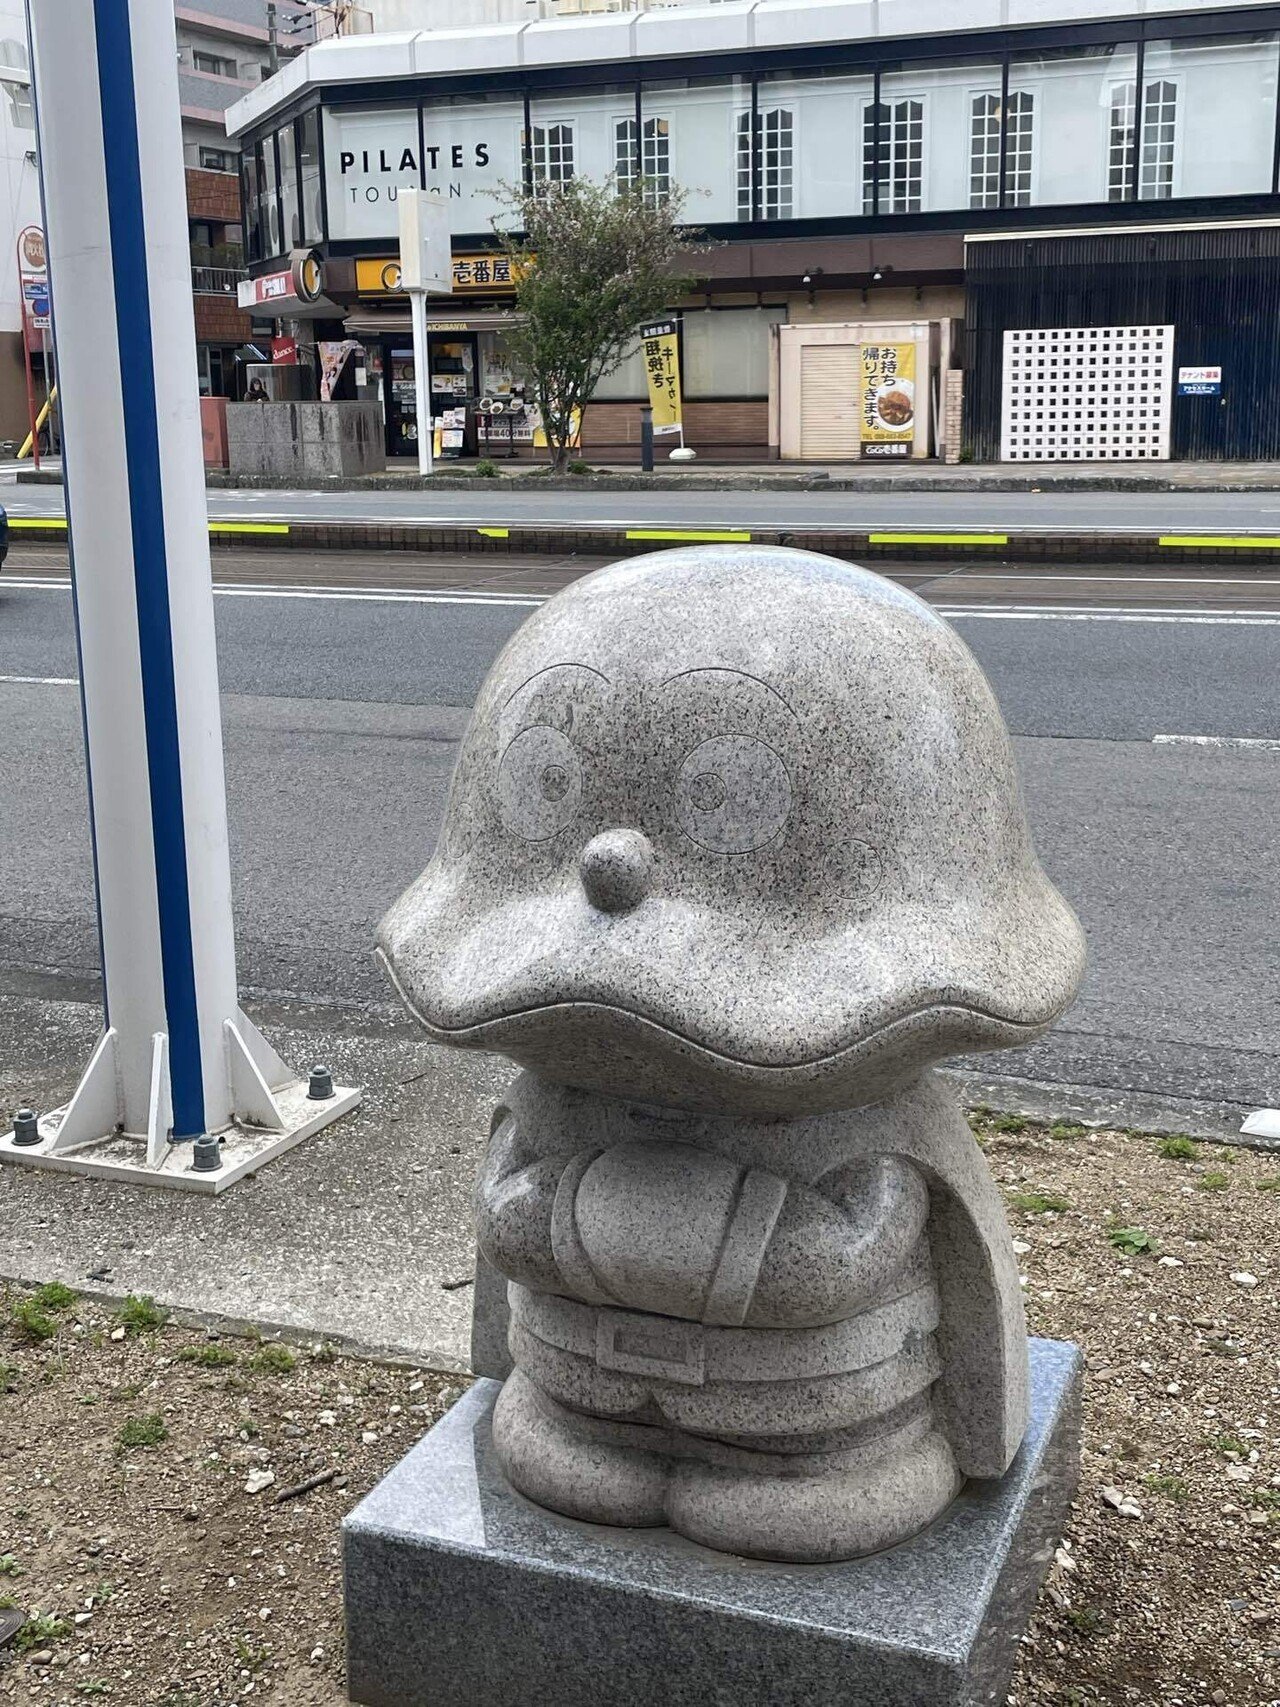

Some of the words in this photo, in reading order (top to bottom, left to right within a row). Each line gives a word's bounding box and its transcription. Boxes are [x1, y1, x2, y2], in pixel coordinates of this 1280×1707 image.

[340, 143, 489, 174] PILATES
[452, 259, 511, 284] 壱番屋
[881, 347, 897, 387] お持ち
[1181, 371, 1219, 379] テナント募集
